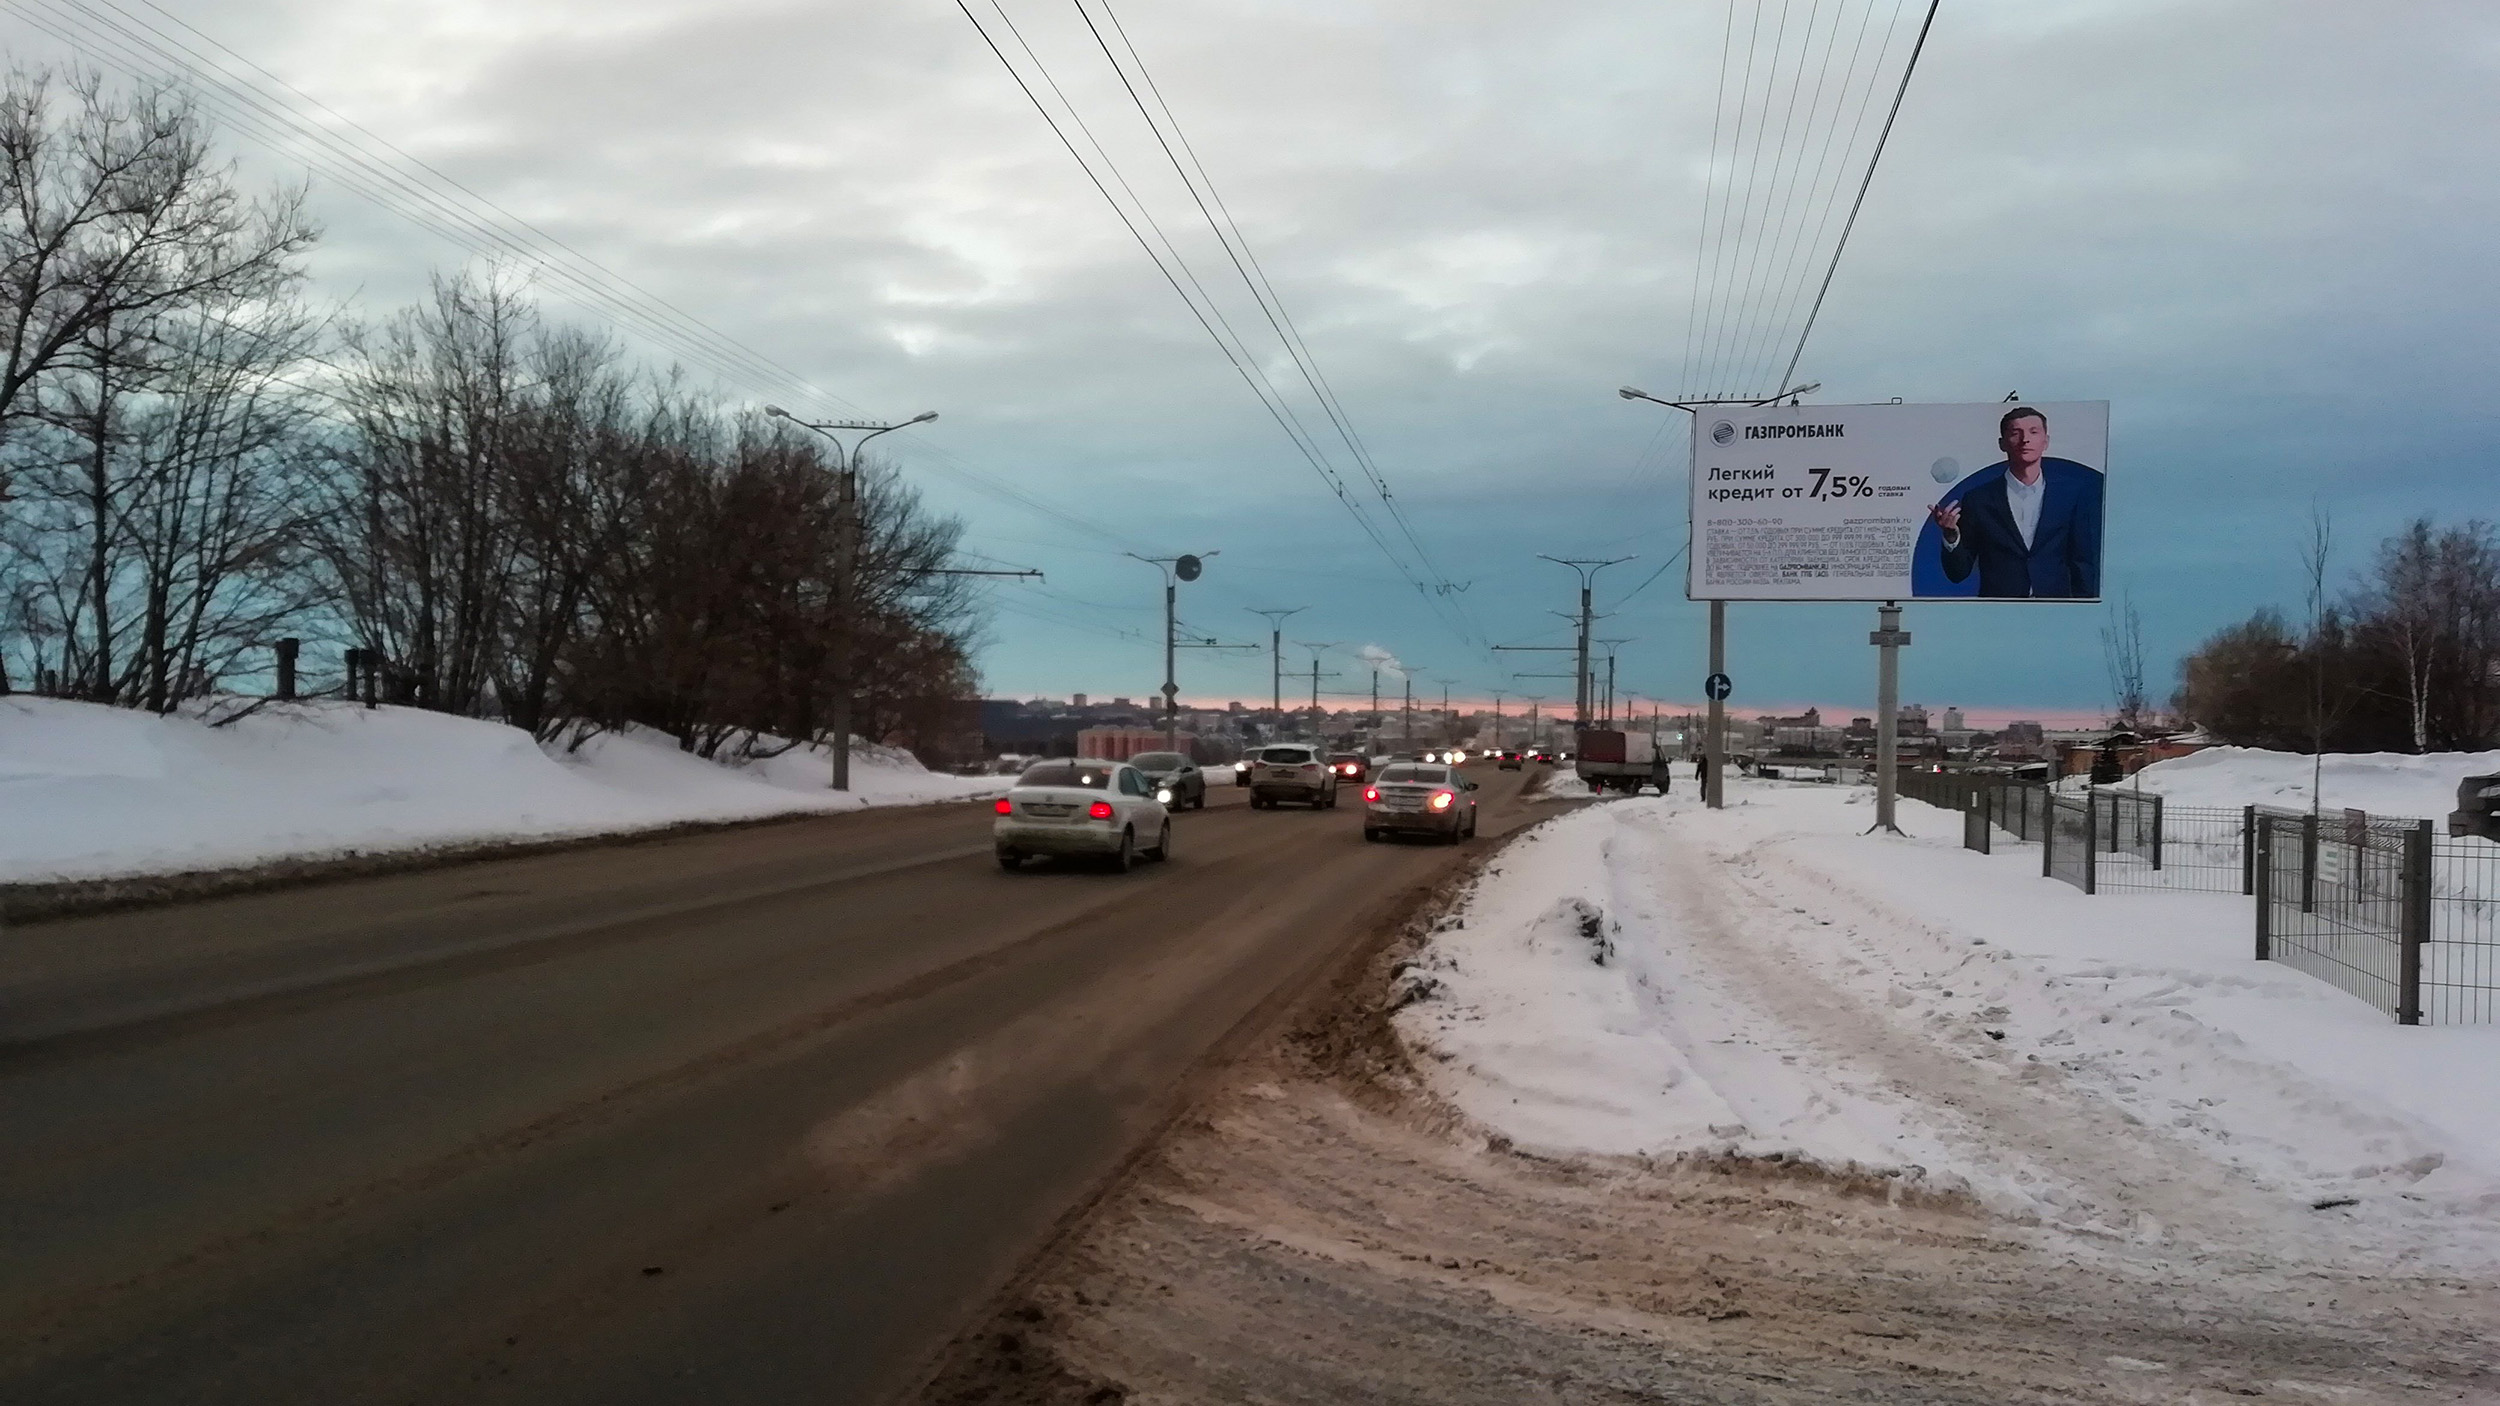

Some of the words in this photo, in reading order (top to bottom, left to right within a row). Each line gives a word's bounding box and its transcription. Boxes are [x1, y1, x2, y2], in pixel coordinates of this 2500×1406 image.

[1745, 424, 1845, 440] ГАЗПРОМБАНК
[1708, 464, 1775, 481] Легкий
[1708, 487, 1775, 502] кредит
[1781, 487, 1804, 499] от
[1808, 468, 1874, 502] 7,5%
[1707, 518, 1783, 526] 8-800-300-60-90
[1843, 516, 1912, 525] gazprombank.ru
